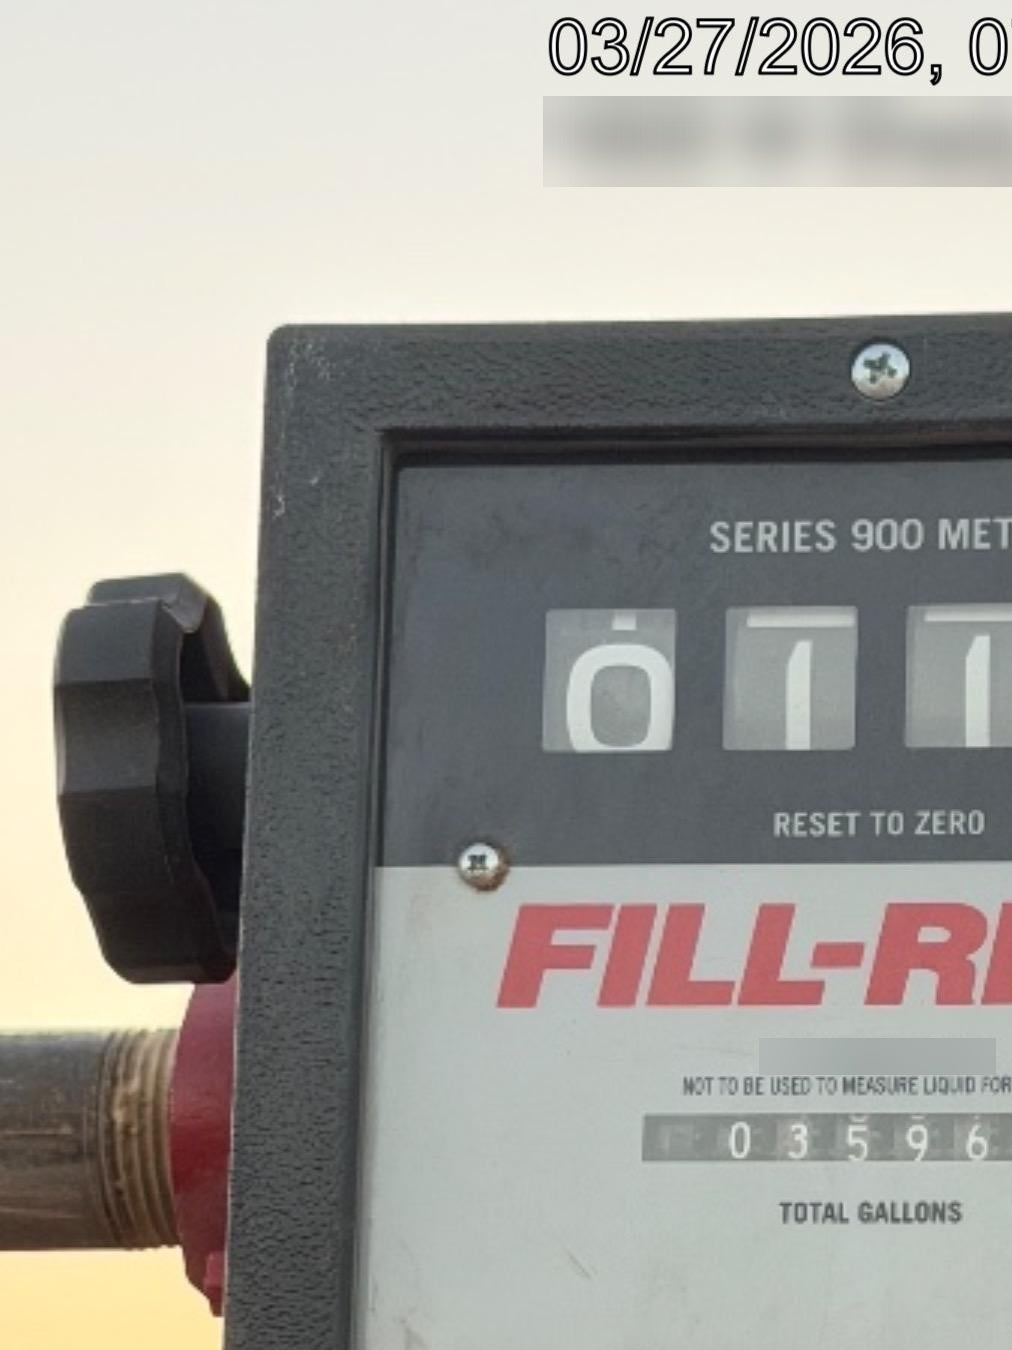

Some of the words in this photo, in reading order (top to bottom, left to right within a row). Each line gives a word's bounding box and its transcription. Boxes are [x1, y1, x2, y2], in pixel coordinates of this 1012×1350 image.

[709, 519, 837, 553] SERIES
[850, 518, 924, 551] 900
[773, 811, 861, 838] RESET
[870, 810, 904, 837] TO
[914, 809, 985, 836] ZERO
[683, 1077, 713, 1096] NOT
[718, 1077, 739, 1096] TO
[743, 1076, 765, 1095] BE
[770, 1076, 812, 1095] USED
[815, 1076, 838, 1095] TO
[842, 1076, 918, 1095] MEASURE
[923, 1076, 976, 1095] LIQUID
[981, 1075, 1011, 1094] FOR
[780, 1202, 849, 1225] TOTAL
[858, 1201, 963, 1224] GALLONS
